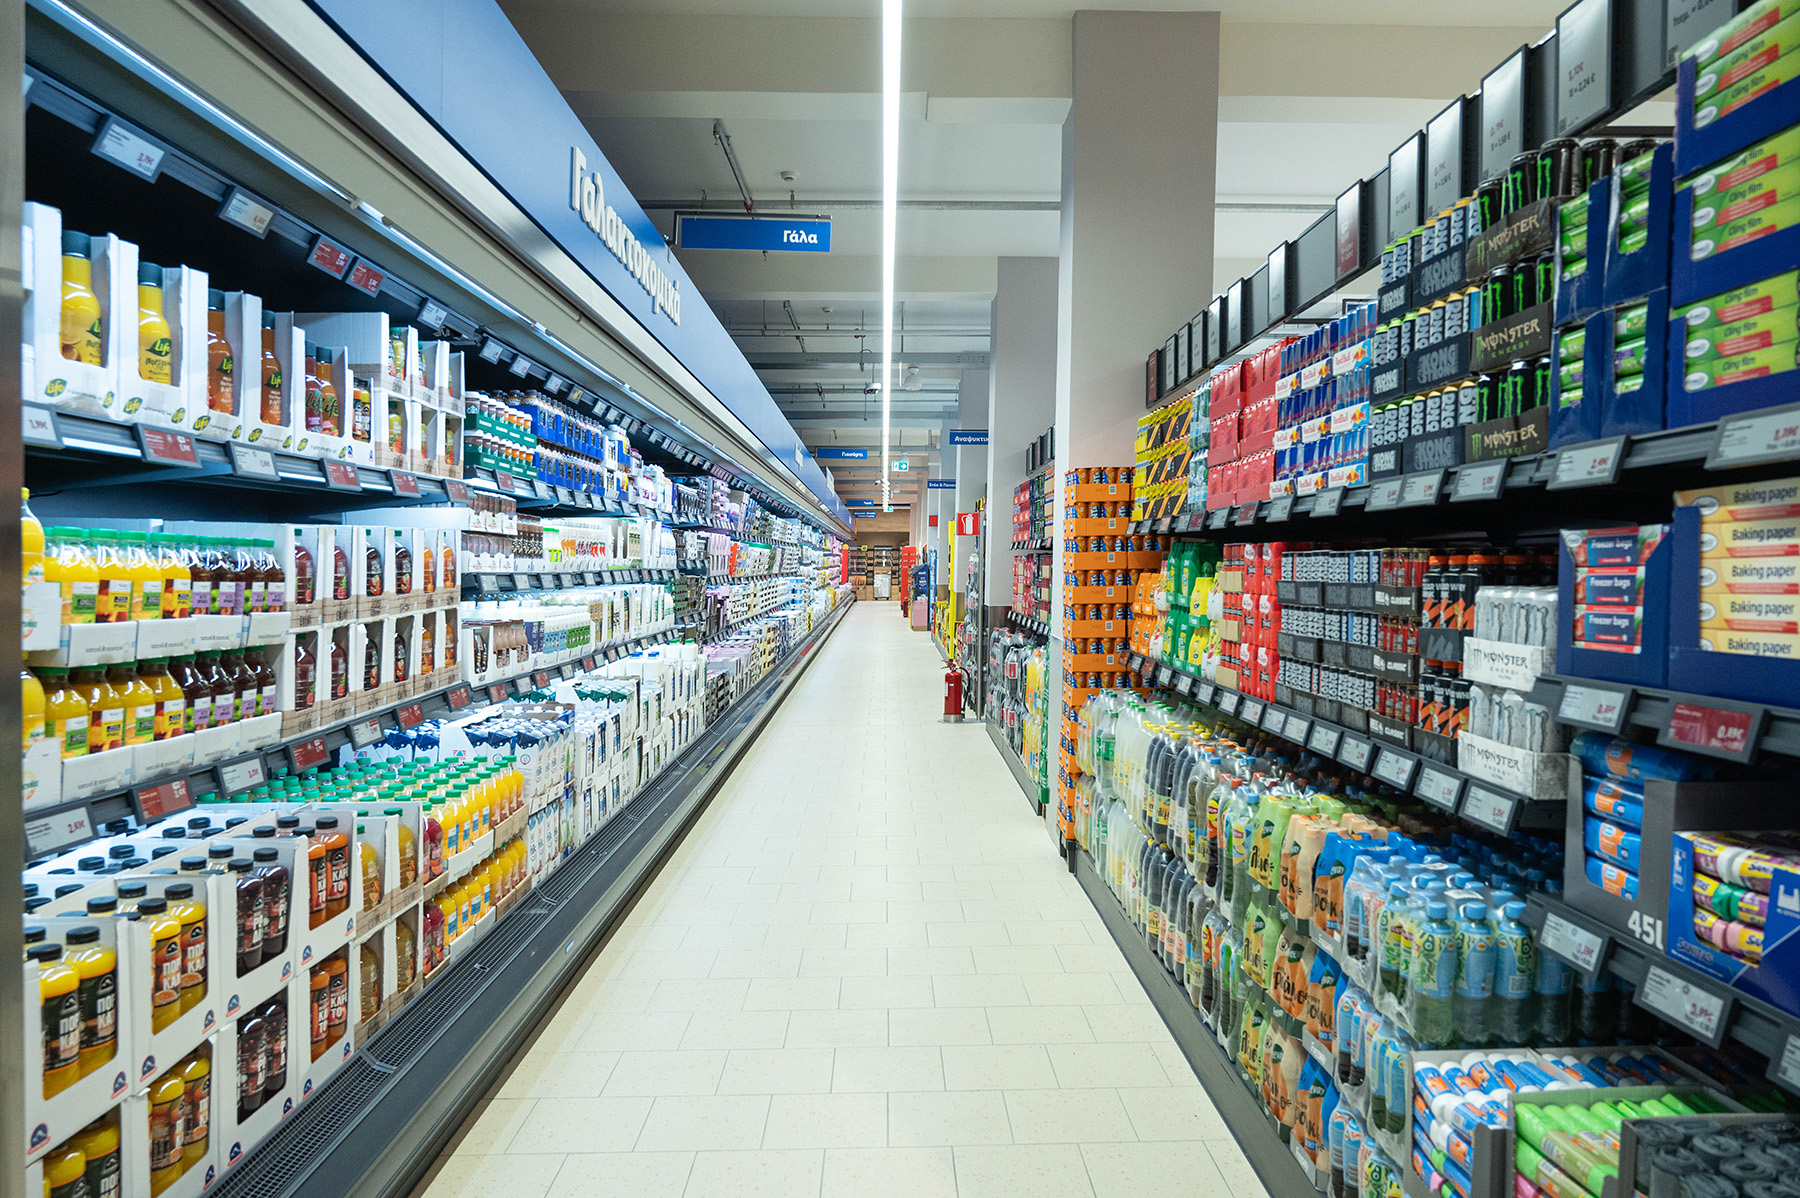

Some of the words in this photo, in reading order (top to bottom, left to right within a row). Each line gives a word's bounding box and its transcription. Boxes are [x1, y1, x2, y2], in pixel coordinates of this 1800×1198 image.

[571, 146, 681, 326] Γαλακτοκομικά
[783, 229, 818, 244] Γάλα
[1482, 318, 1540, 351] MONSTER
[46, 381, 64, 395] Life
[1484, 424, 1538, 448] MONSTER
[1733, 489, 1767, 503] Baking
[1768, 486, 1798, 502] paper
[1732, 528, 1765, 542] Baking
[1767, 526, 1797, 541] paper
[1591, 540, 1614, 548] Freezer
[1615, 538, 1633, 550] bags
[1732, 565, 1764, 579] Baking
[1766, 565, 1796, 580] paper
[1590, 577, 1613, 587] Freezer
[1614, 576, 1631, 589] bags
[1730, 601, 1763, 616] Baking
[1764, 602, 1794, 617] paper
[1588, 614, 1612, 626] Freezer
[1613, 616, 1629, 628] bags
[1728, 638, 1761, 655] Baking
[1762, 642, 1792, 656] paper
[1483, 650, 1528, 668] MONSTER
[1477, 747, 1520, 772] MONSTER
